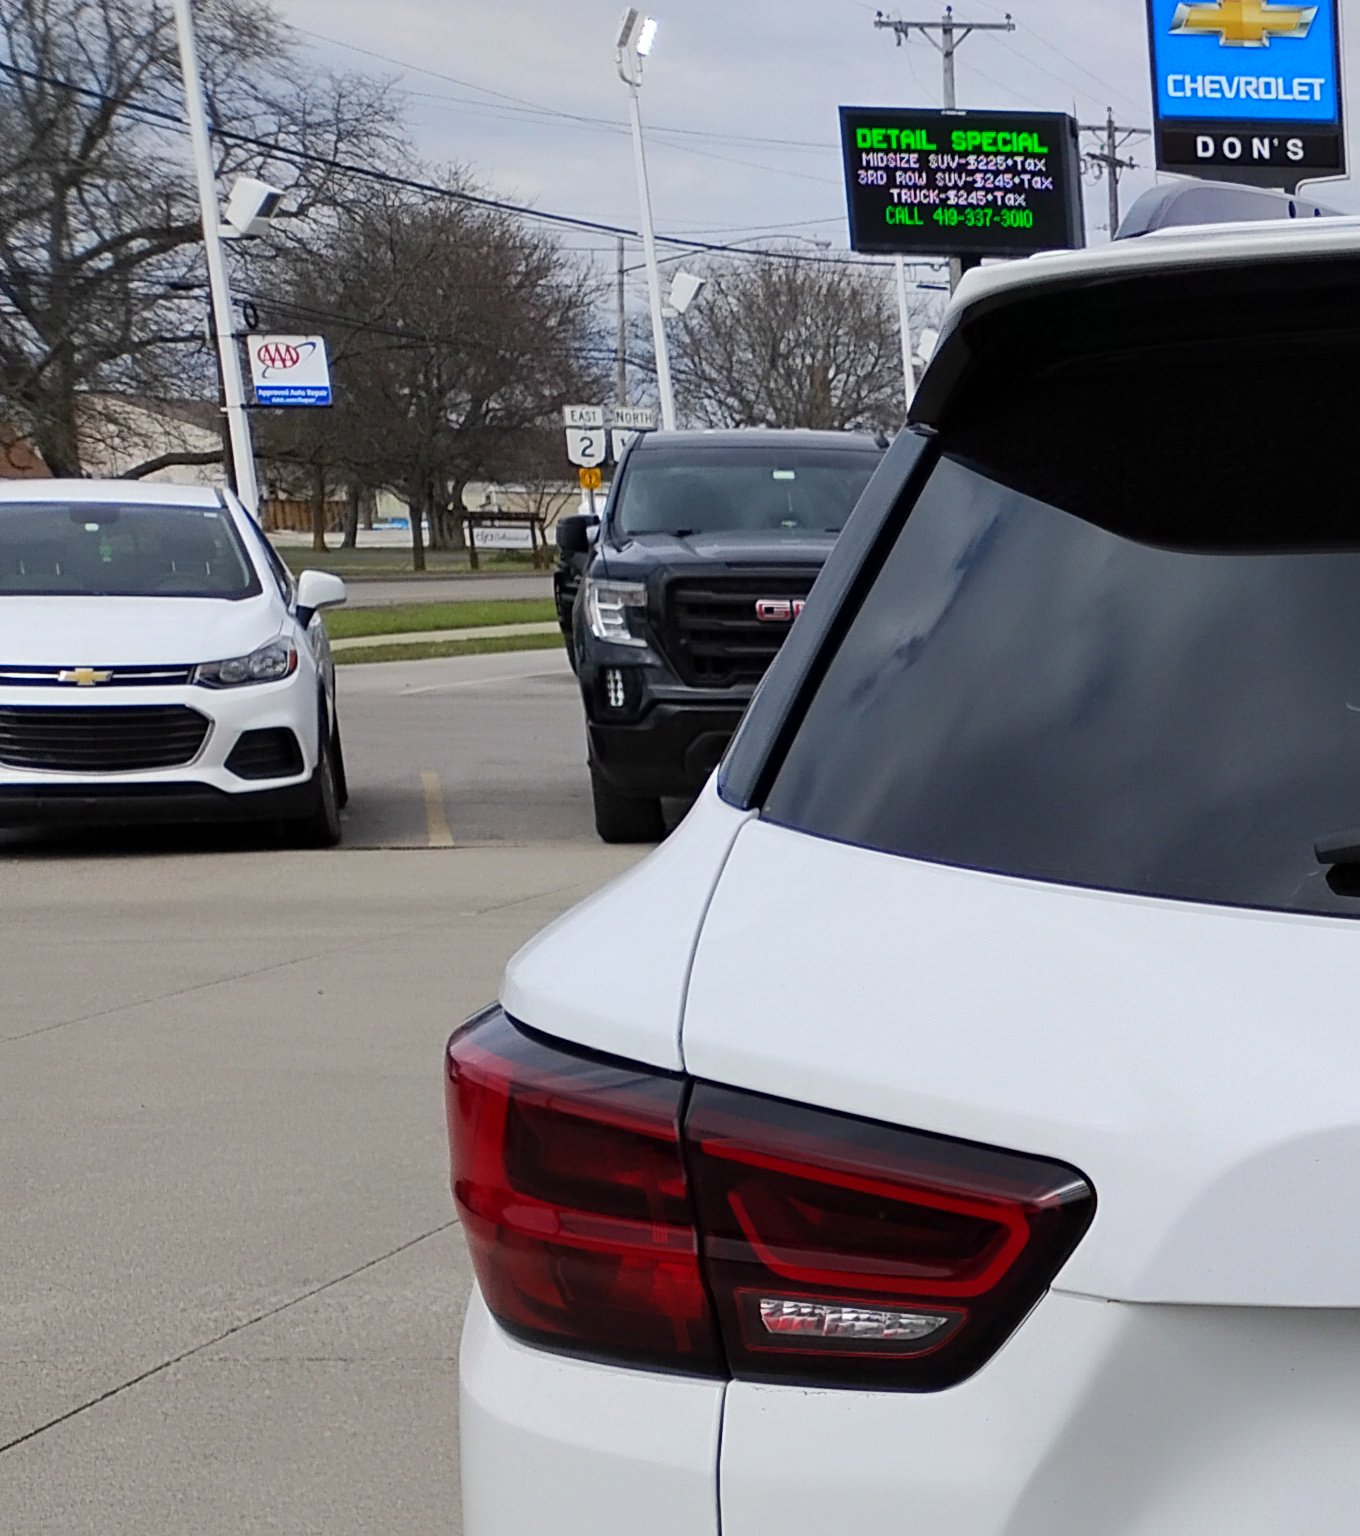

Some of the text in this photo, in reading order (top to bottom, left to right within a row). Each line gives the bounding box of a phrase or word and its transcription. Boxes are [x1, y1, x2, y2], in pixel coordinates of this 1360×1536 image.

[1167, 74, 1326, 101] CHEVROLET
[856, 128, 1049, 153] DETAIL SPECIAL
[1196, 135, 1304, 161] DON'S
[861, 152, 920, 168] MIDSIZE
[857, 169, 887, 185] 3RD
[896, 170, 927, 186] ROW
[885, 206, 1034, 228] CALL 419-337-3010
[261, 343, 298, 369] AAA
[570, 410, 597, 423] EAST
[615, 410, 653, 424] NORTH
[580, 436, 595, 458] 2
